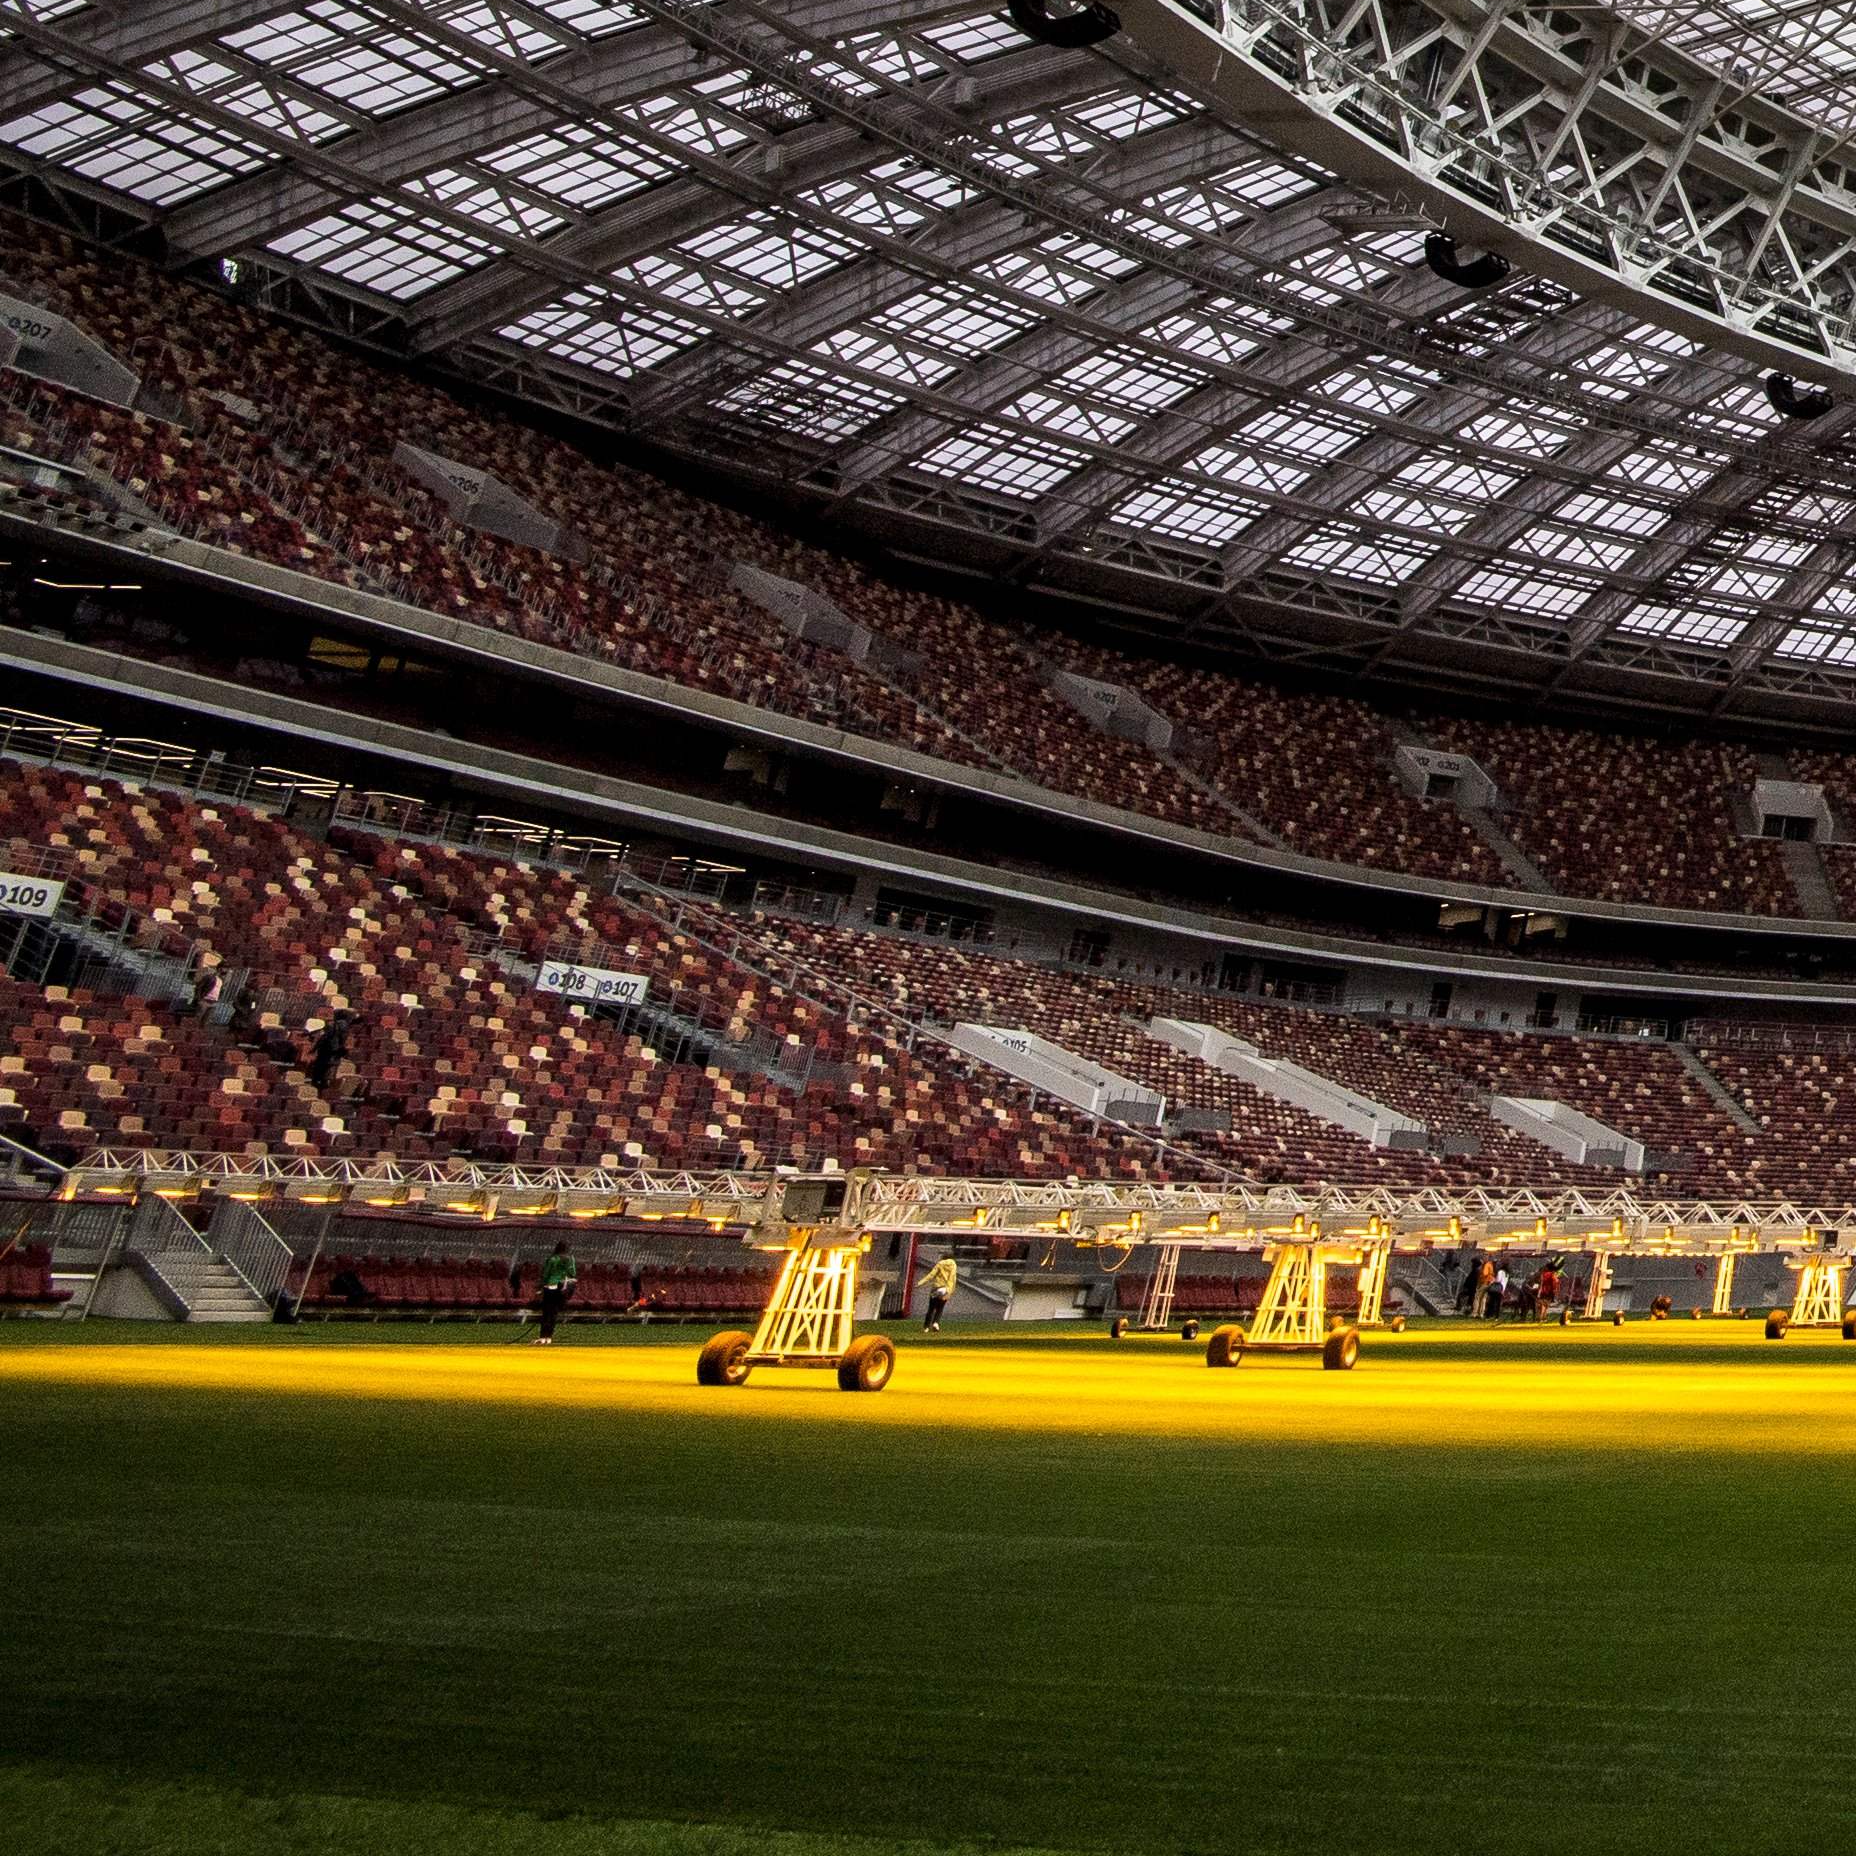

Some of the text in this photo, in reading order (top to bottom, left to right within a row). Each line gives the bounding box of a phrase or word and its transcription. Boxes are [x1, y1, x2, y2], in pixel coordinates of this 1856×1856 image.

[20, 319, 52, 340] 207
[6, 885, 48, 907] 109
[558, 973, 638, 996] 108 107
